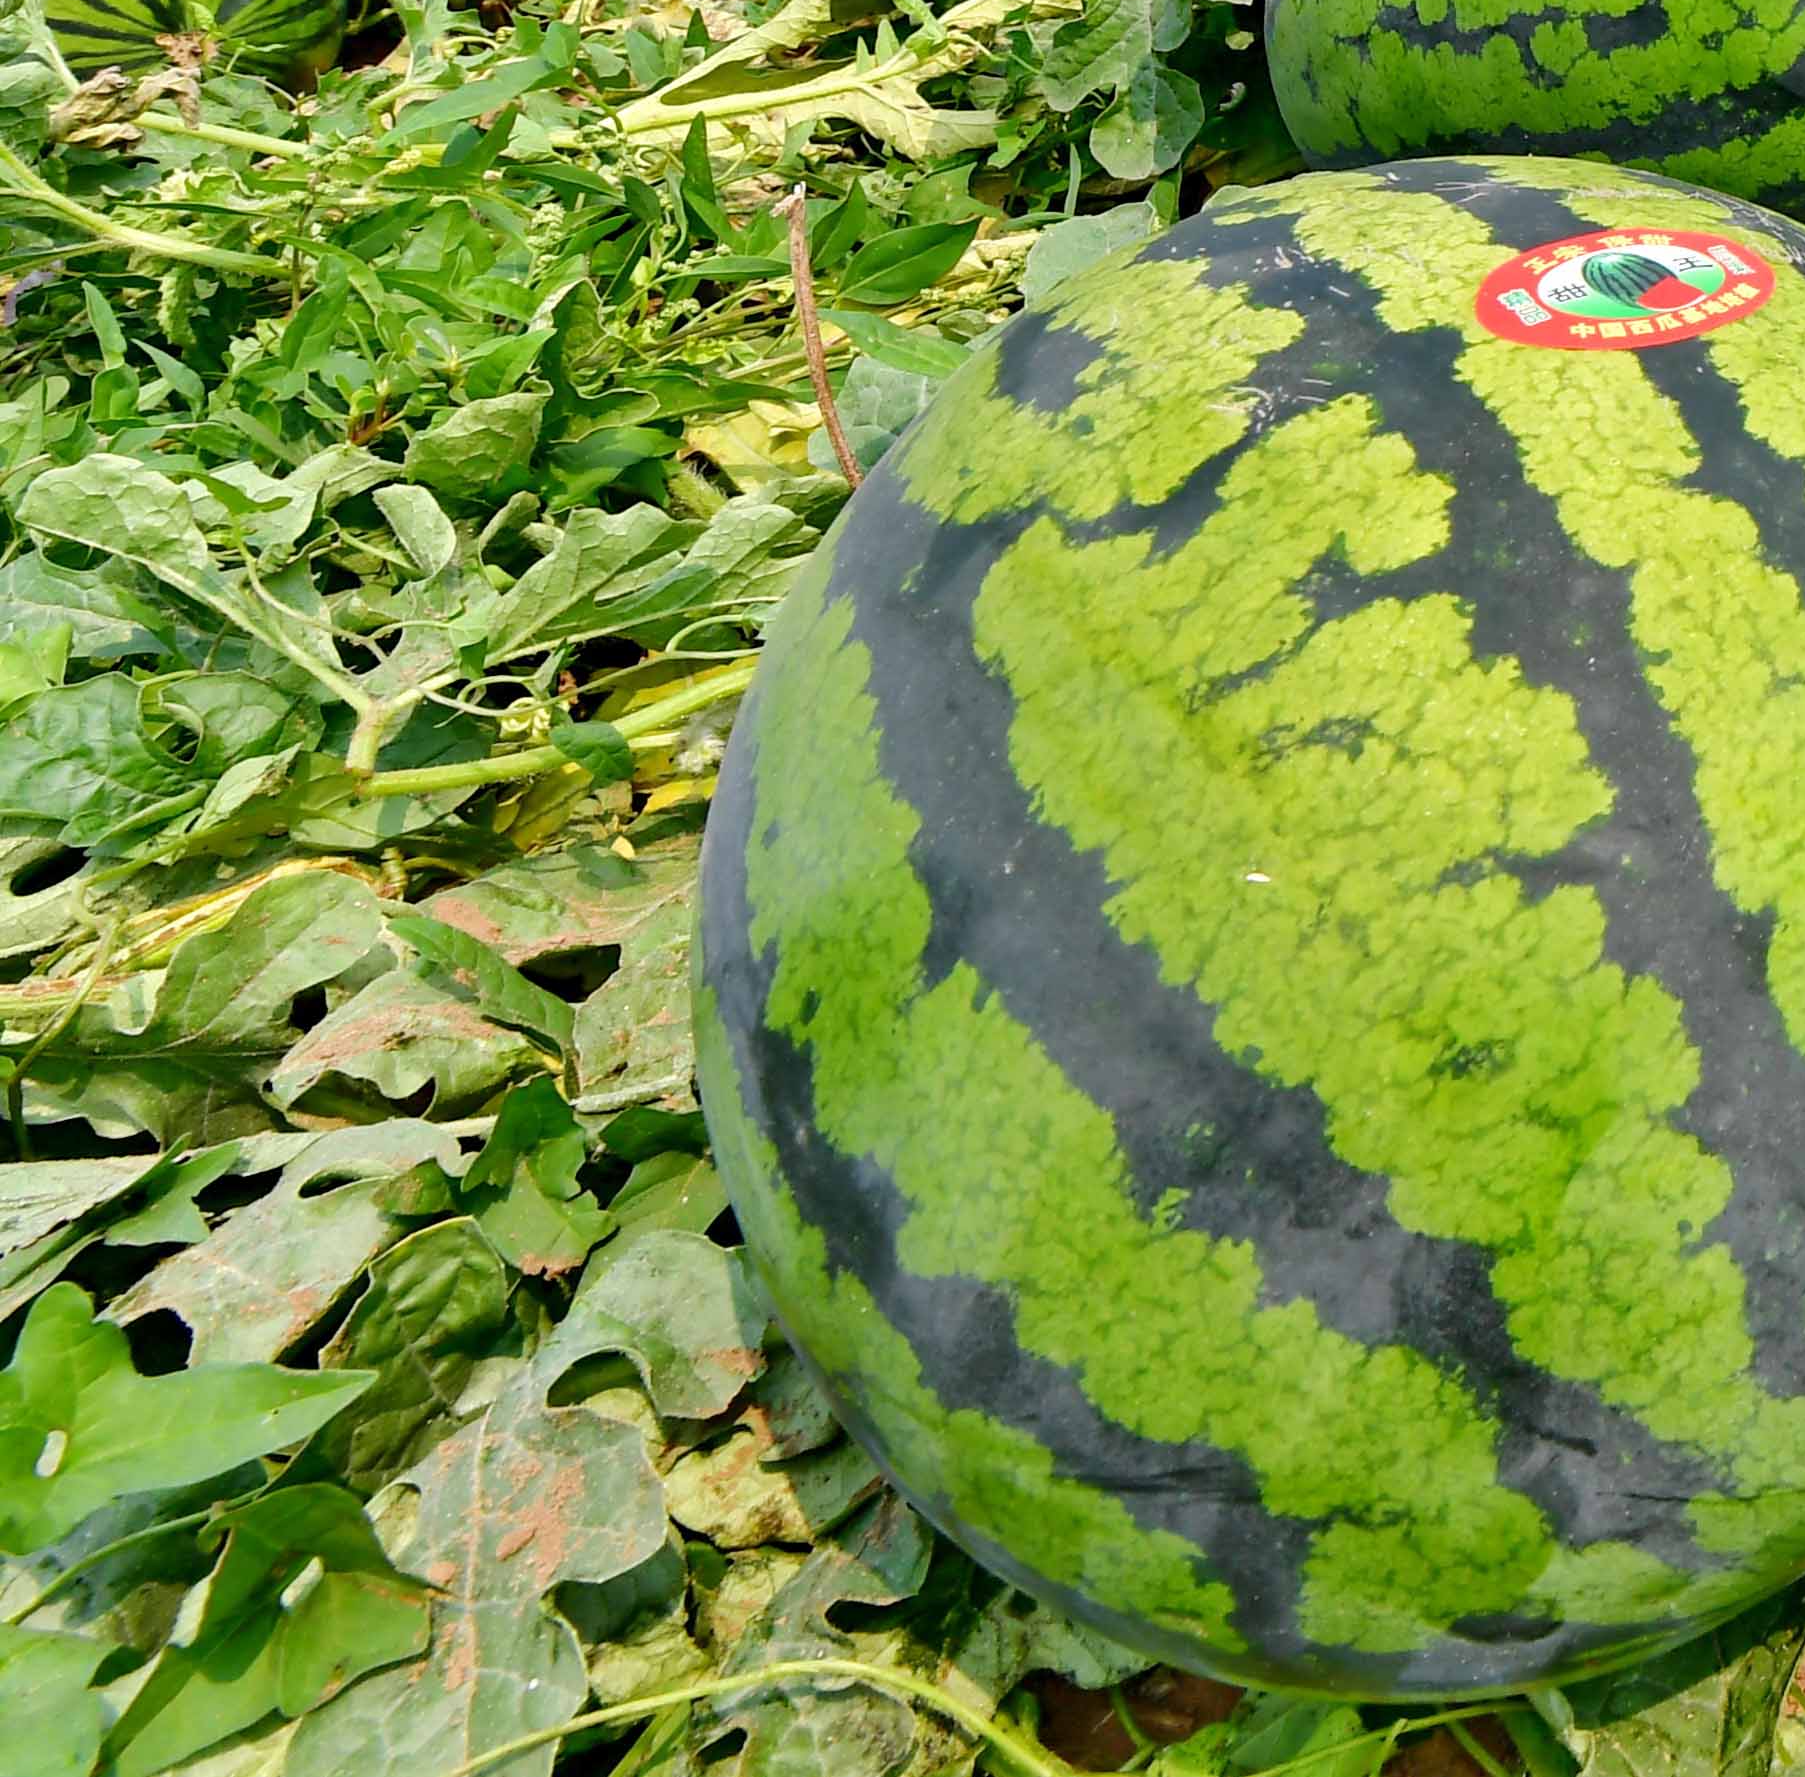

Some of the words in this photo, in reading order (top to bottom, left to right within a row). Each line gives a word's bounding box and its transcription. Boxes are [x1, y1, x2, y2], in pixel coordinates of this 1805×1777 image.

[1548, 283, 1588, 303] 甜
[1673, 256, 1714, 273] 王
[1497, 288, 1553, 326] 精品
